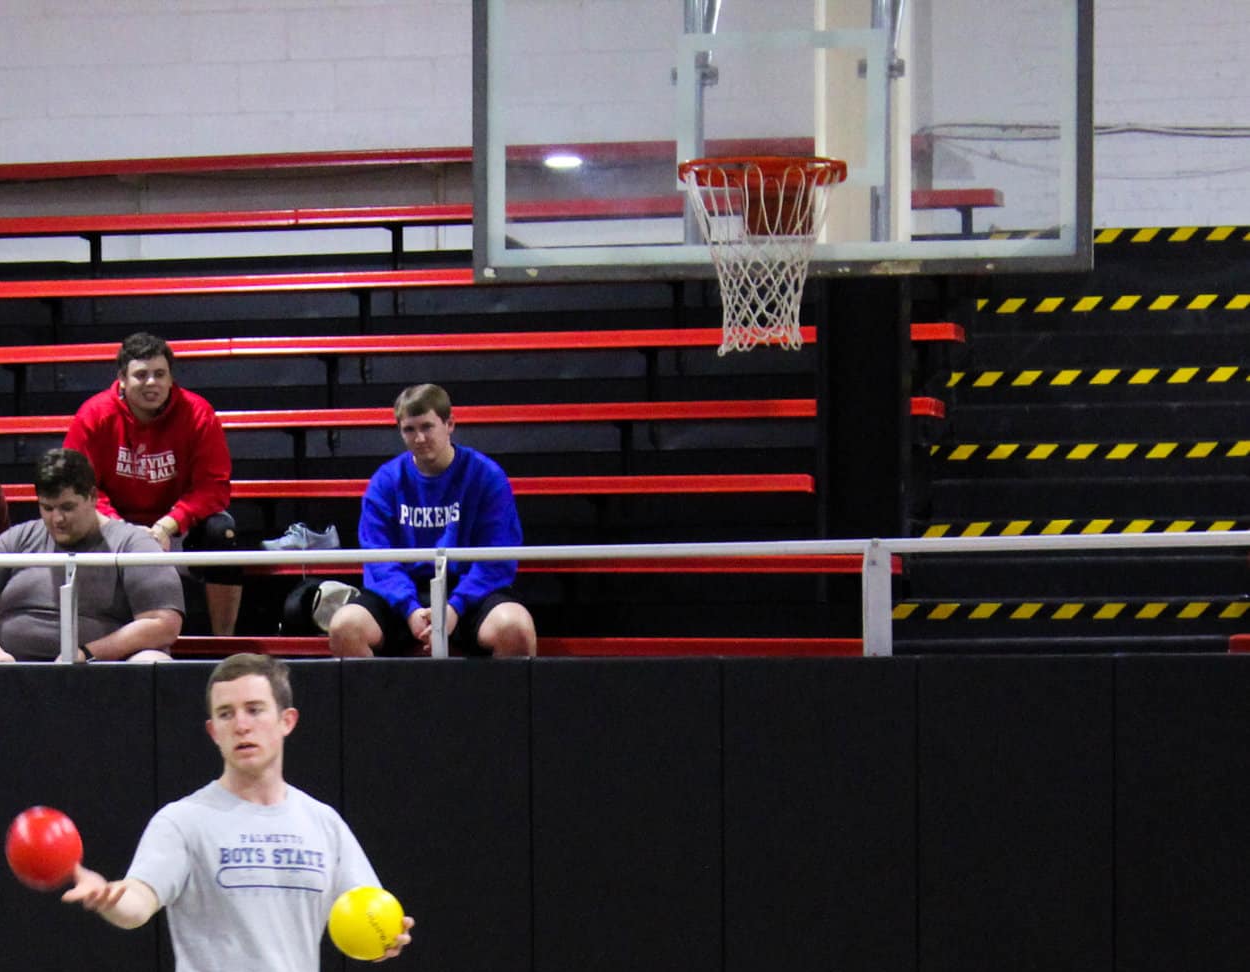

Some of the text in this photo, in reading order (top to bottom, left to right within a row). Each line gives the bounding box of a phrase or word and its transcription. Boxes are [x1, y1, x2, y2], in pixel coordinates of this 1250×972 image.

[399, 502, 460, 528] PICKENS
[219, 848, 325, 868] BOYS STATE
